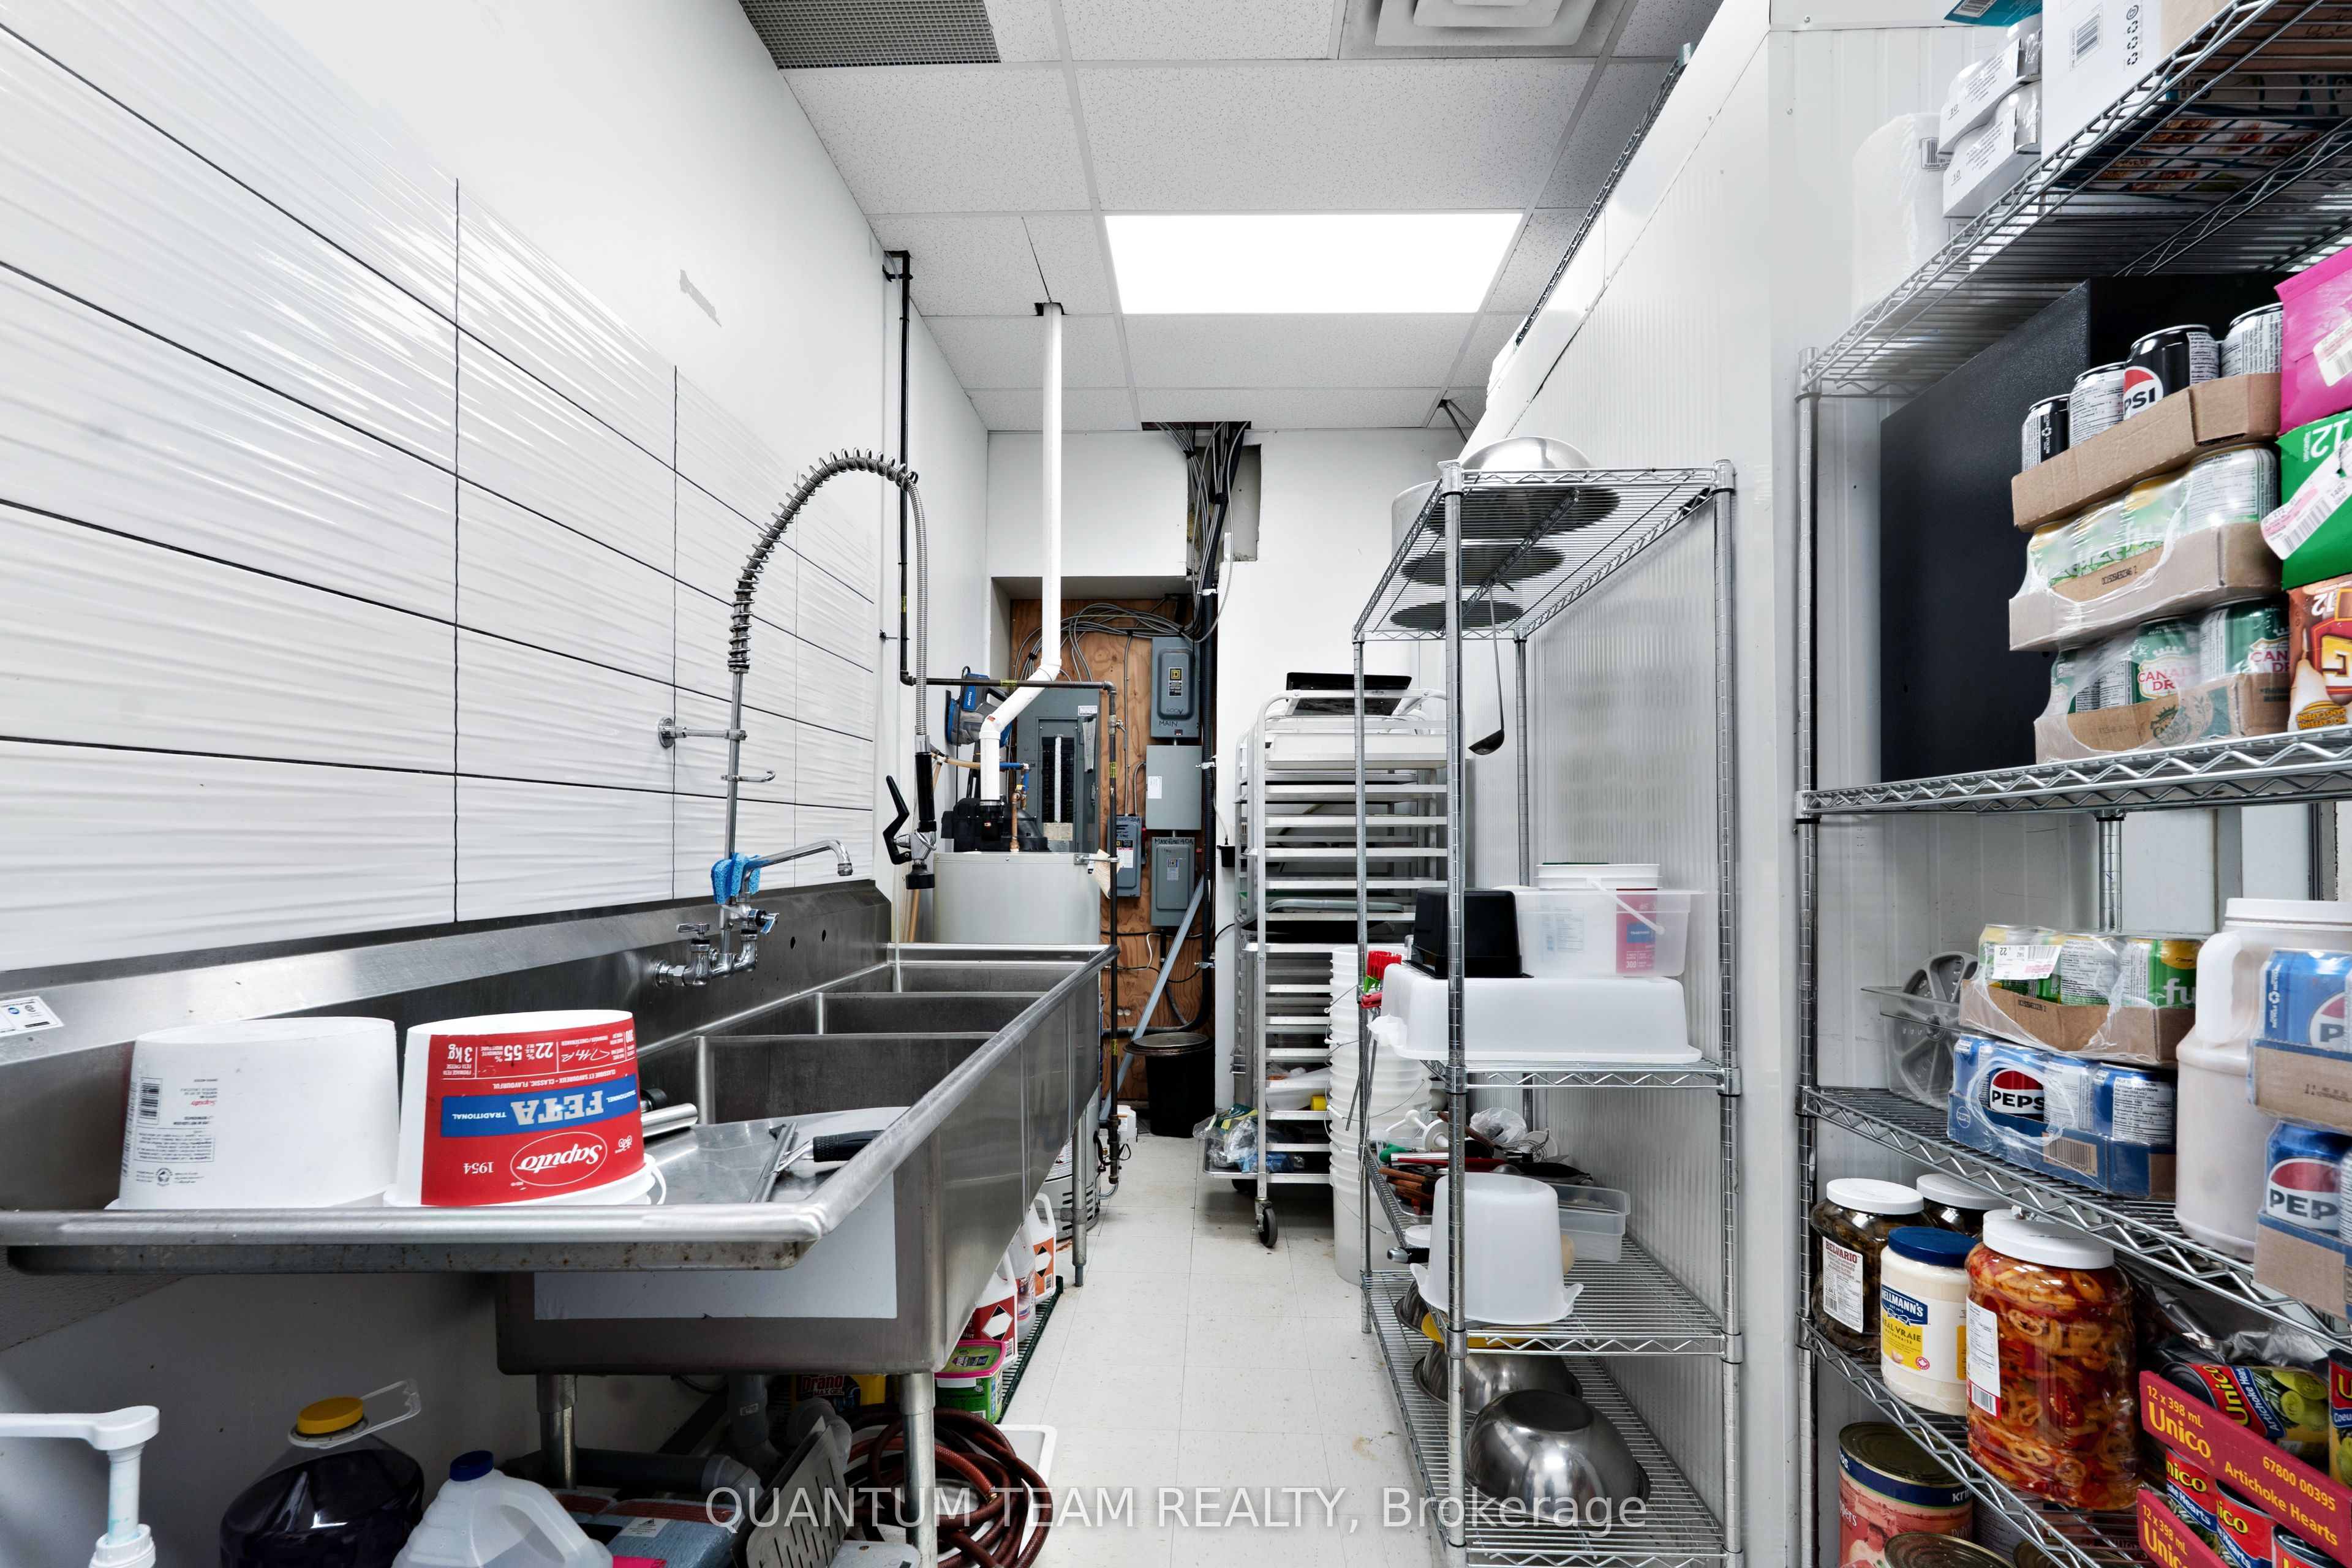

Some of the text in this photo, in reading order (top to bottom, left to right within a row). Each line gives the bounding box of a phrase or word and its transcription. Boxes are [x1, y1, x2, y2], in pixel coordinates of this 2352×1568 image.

[1950, 104, 1958, 115] 10
[1953, 170, 1960, 181] 10
[2311, 590, 2335, 616] 12
[2153, 678, 2186, 692] DRY
[2297, 716, 2346, 729] NO CAFFEINE
[2326, 707, 2346, 718] SANS
[505, 1045, 522, 1061] 55
[536, 1042, 554, 1058] 22
[559, 1074, 589, 1084] SAVOUREUX
[594, 1069, 616, 1079] CLASSIQUE
[606, 1089, 636, 1102] TRADITIONNEL
[1992, 1090, 2044, 1110] PEPS
[510, 1090, 604, 1126] FETA
[463, 1161, 494, 1174] 1954
[516, 1143, 603, 1173] Saputo
[2270, 1188, 2338, 1220] PEP
[1825, 1240, 1858, 1264] BELVARIO
[813, 1389, 829, 1397] MAX
[2203, 1365, 2249, 1426] Unico
[2147, 1385, 2204, 1428] 12 x 398 mL
[2248, 1387, 2280, 1431] Artichoke
[2334, 1411, 2352, 1423] Coeu
[2149, 1401, 2211, 1459] Unico
[2263, 1456, 2335, 1512] 67800 00395
[2179, 1491, 2211, 1526] Hearts
[2225, 1461, 2338, 1546] Artichoke Hearts
[2142, 1504, 2188, 1556] 12 x 398 mL
[2143, 1520, 2189, 1568] Unic
